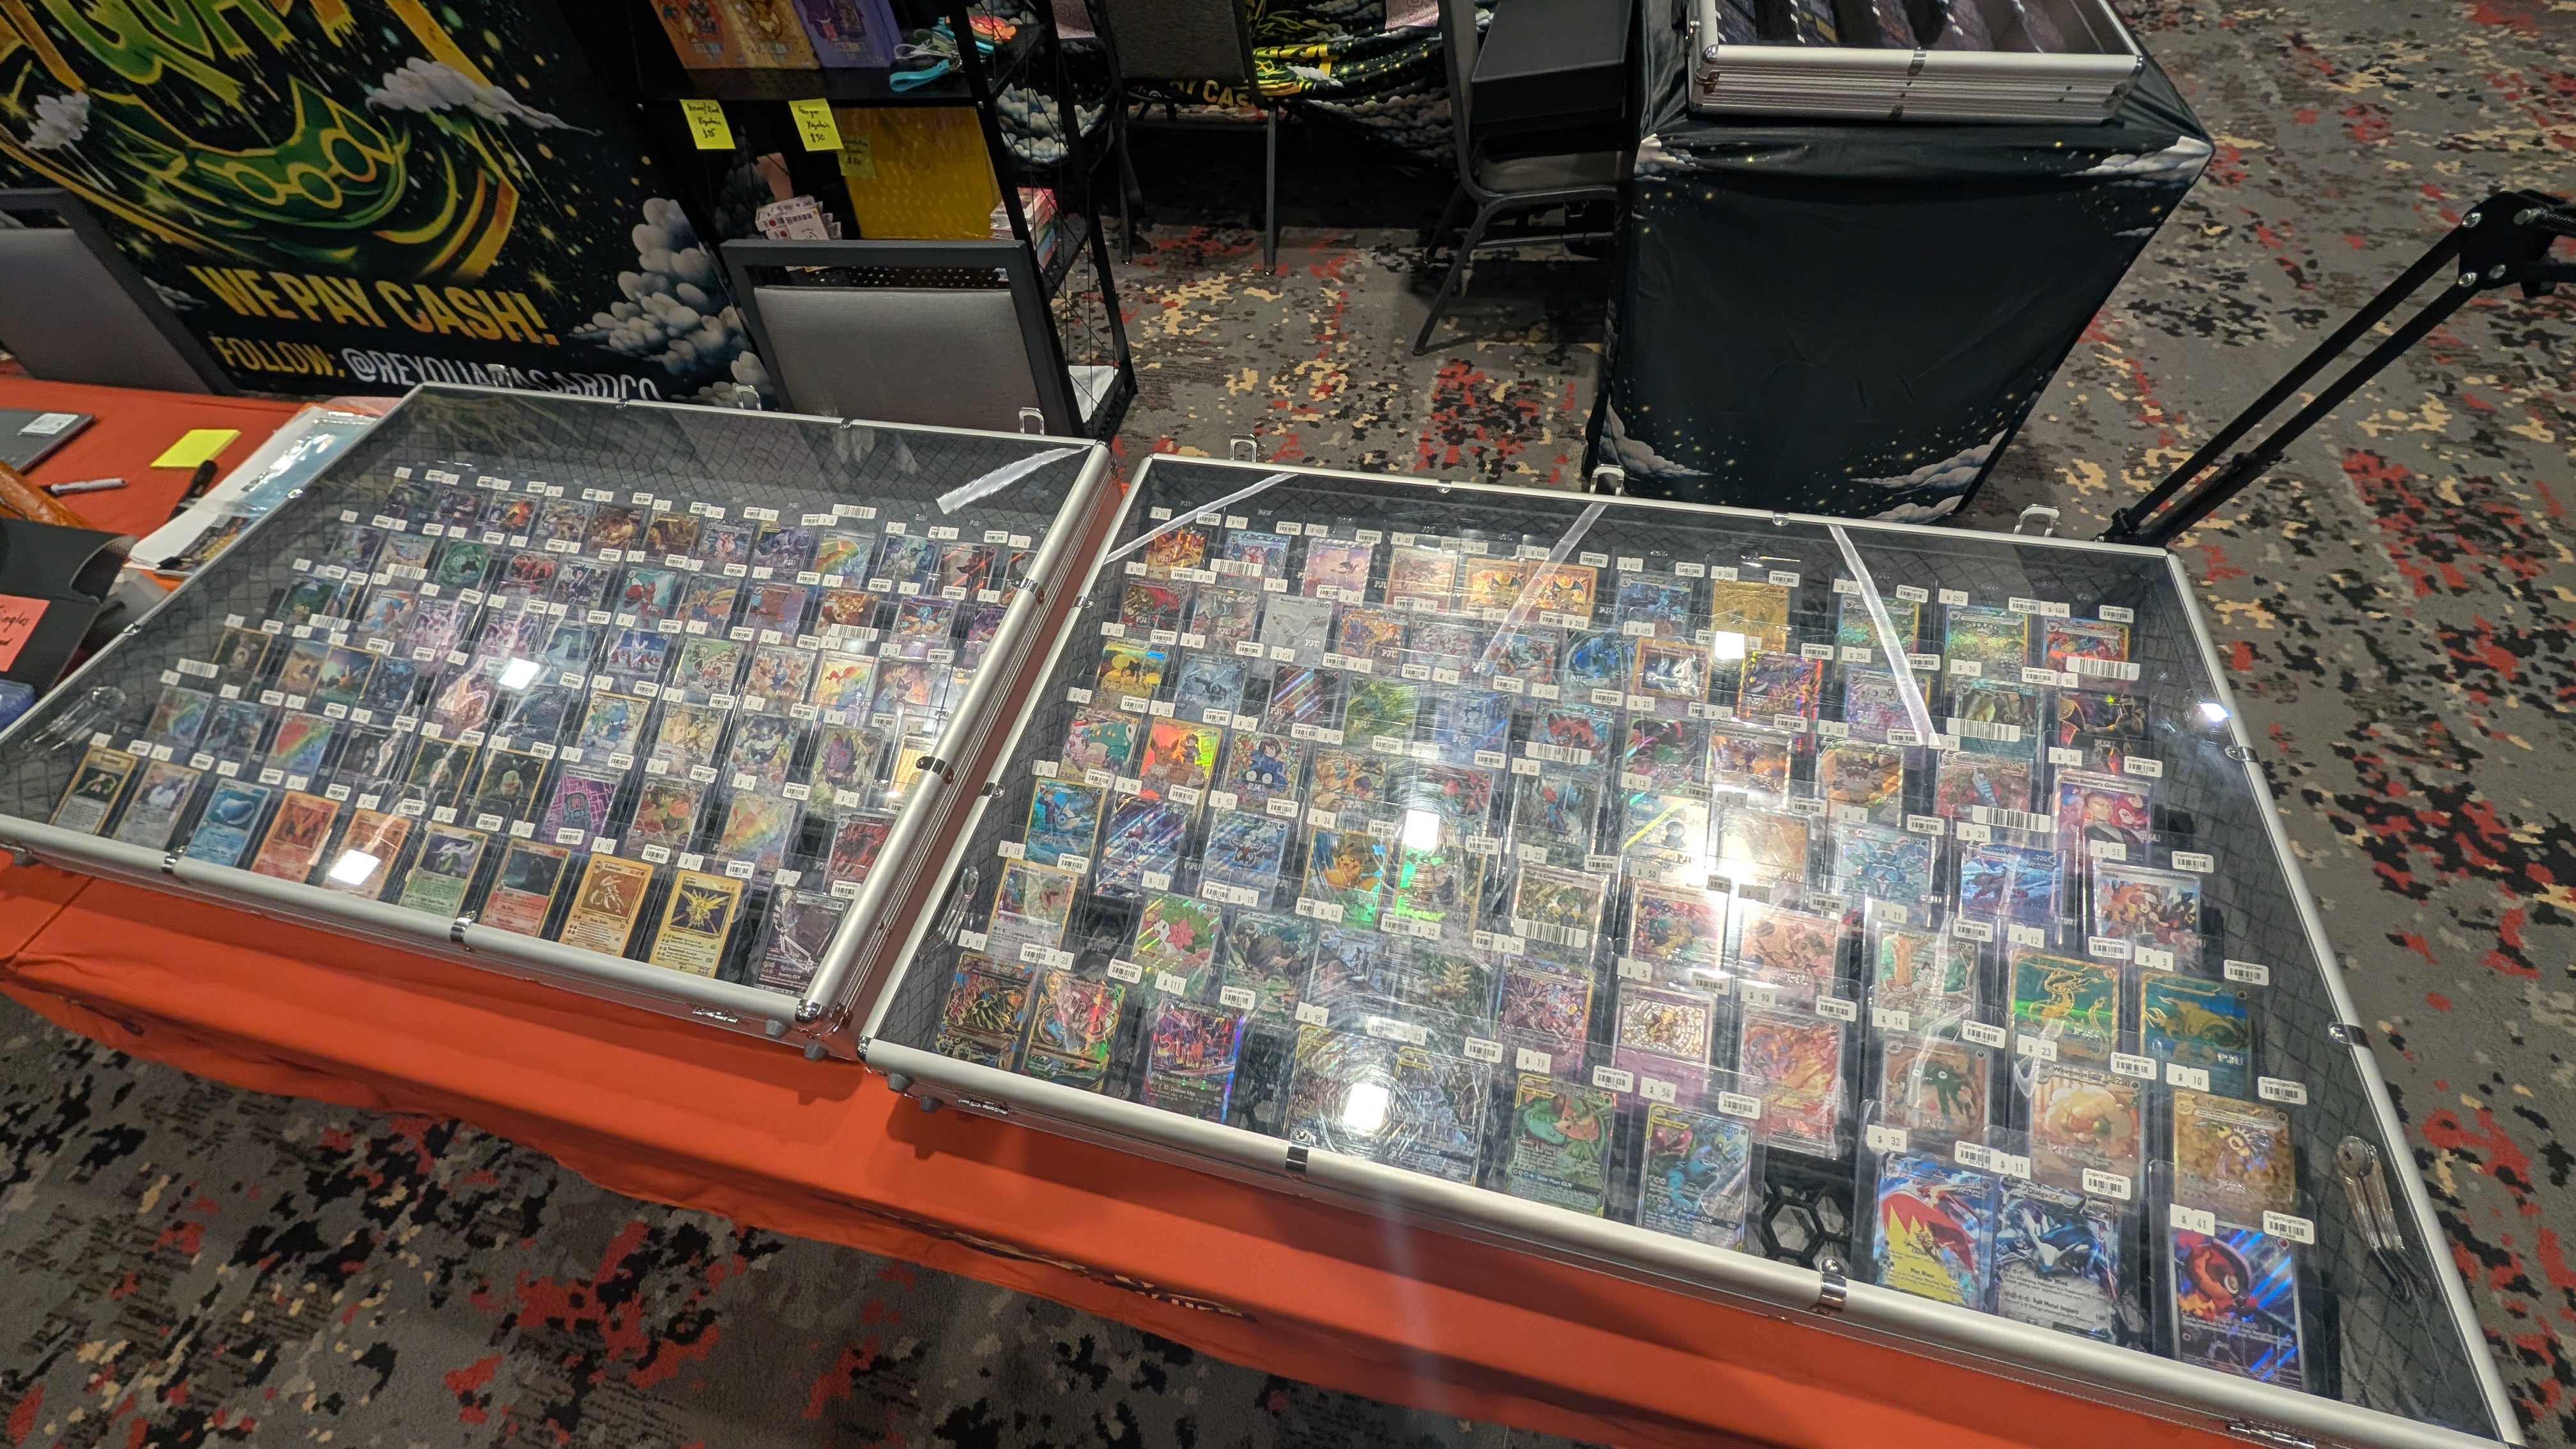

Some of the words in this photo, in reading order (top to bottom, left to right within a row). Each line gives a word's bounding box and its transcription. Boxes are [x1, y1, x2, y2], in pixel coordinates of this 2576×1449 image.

[1203, 80, 1252, 108] CAS
[187, 266, 299, 319] WE
[268, 271, 387, 328] PAY
[375, 280, 560, 346] CASH!
[210, 330, 345, 378] FOLLOW:
[1331, 910, 1337, 918] 12
[1427, 928, 1435, 936] 32
[2030, 935, 2039, 945] 12
[1512, 943, 1519, 951] 39
[2145, 954, 2150, 963] $
[1642, 969, 1646, 978] 5
[1170, 980, 1180, 990] 111
[1882, 1015, 1886, 1023] $
[1894, 1016, 1903, 1026] 14
[2041, 1047, 2050, 1057] 23
[2115, 1078, 2129, 1087] 230
[2178, 1073, 2182, 1081] $
[2193, 1075, 2202, 1085] 10
[1650, 1085, 1653, 1094] $
[1878, 1135, 1882, 1144] $
[1891, 1136, 1899, 1146] 32
[2000, 1160, 2005, 1169] $
[2015, 1163, 2023, 1172] 11
[2028, 1188, 2048, 1198] Dialga
[2181, 1215, 2187, 1224] $
[2196, 1218, 2206, 1229] 41
